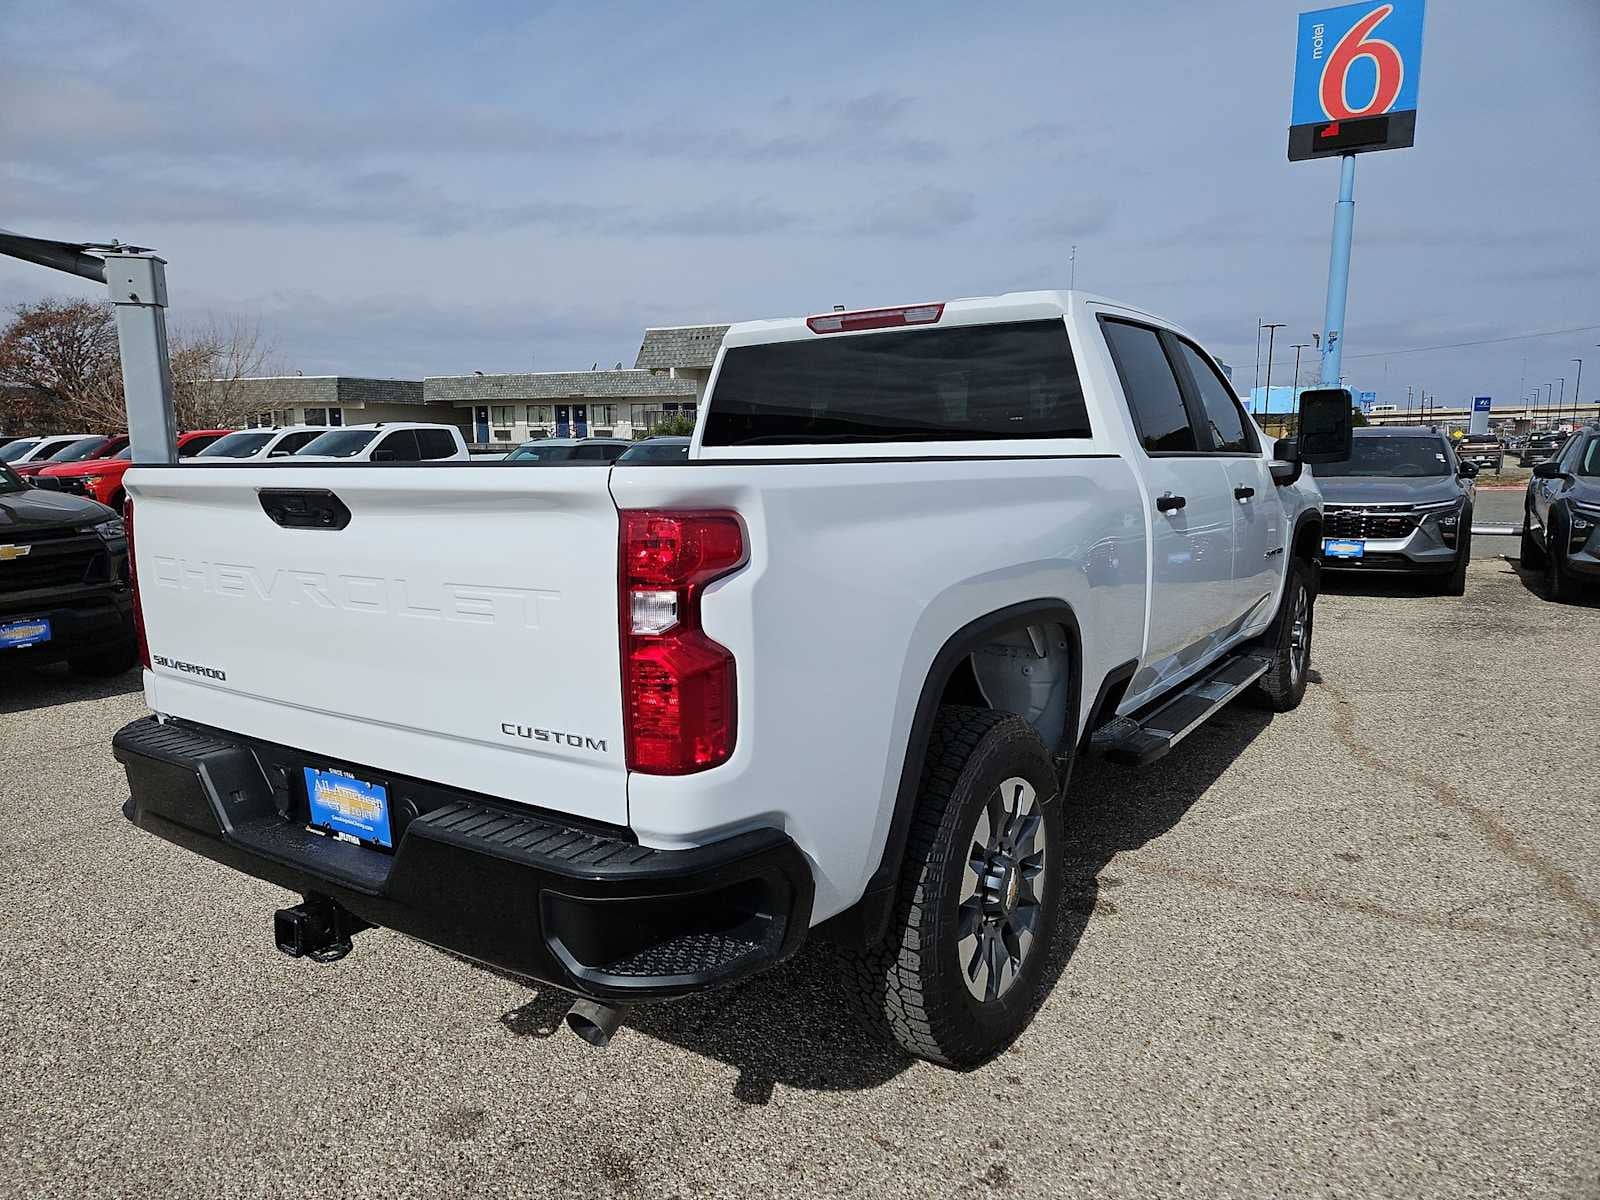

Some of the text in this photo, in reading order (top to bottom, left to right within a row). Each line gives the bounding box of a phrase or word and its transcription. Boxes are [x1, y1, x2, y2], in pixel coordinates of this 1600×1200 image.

[1312, 3, 1405, 121] motel 6
[152, 555, 561, 631] CHEVROLET
[153, 654, 226, 682] SILVERADO
[501, 722, 608, 752] CUSTOM
